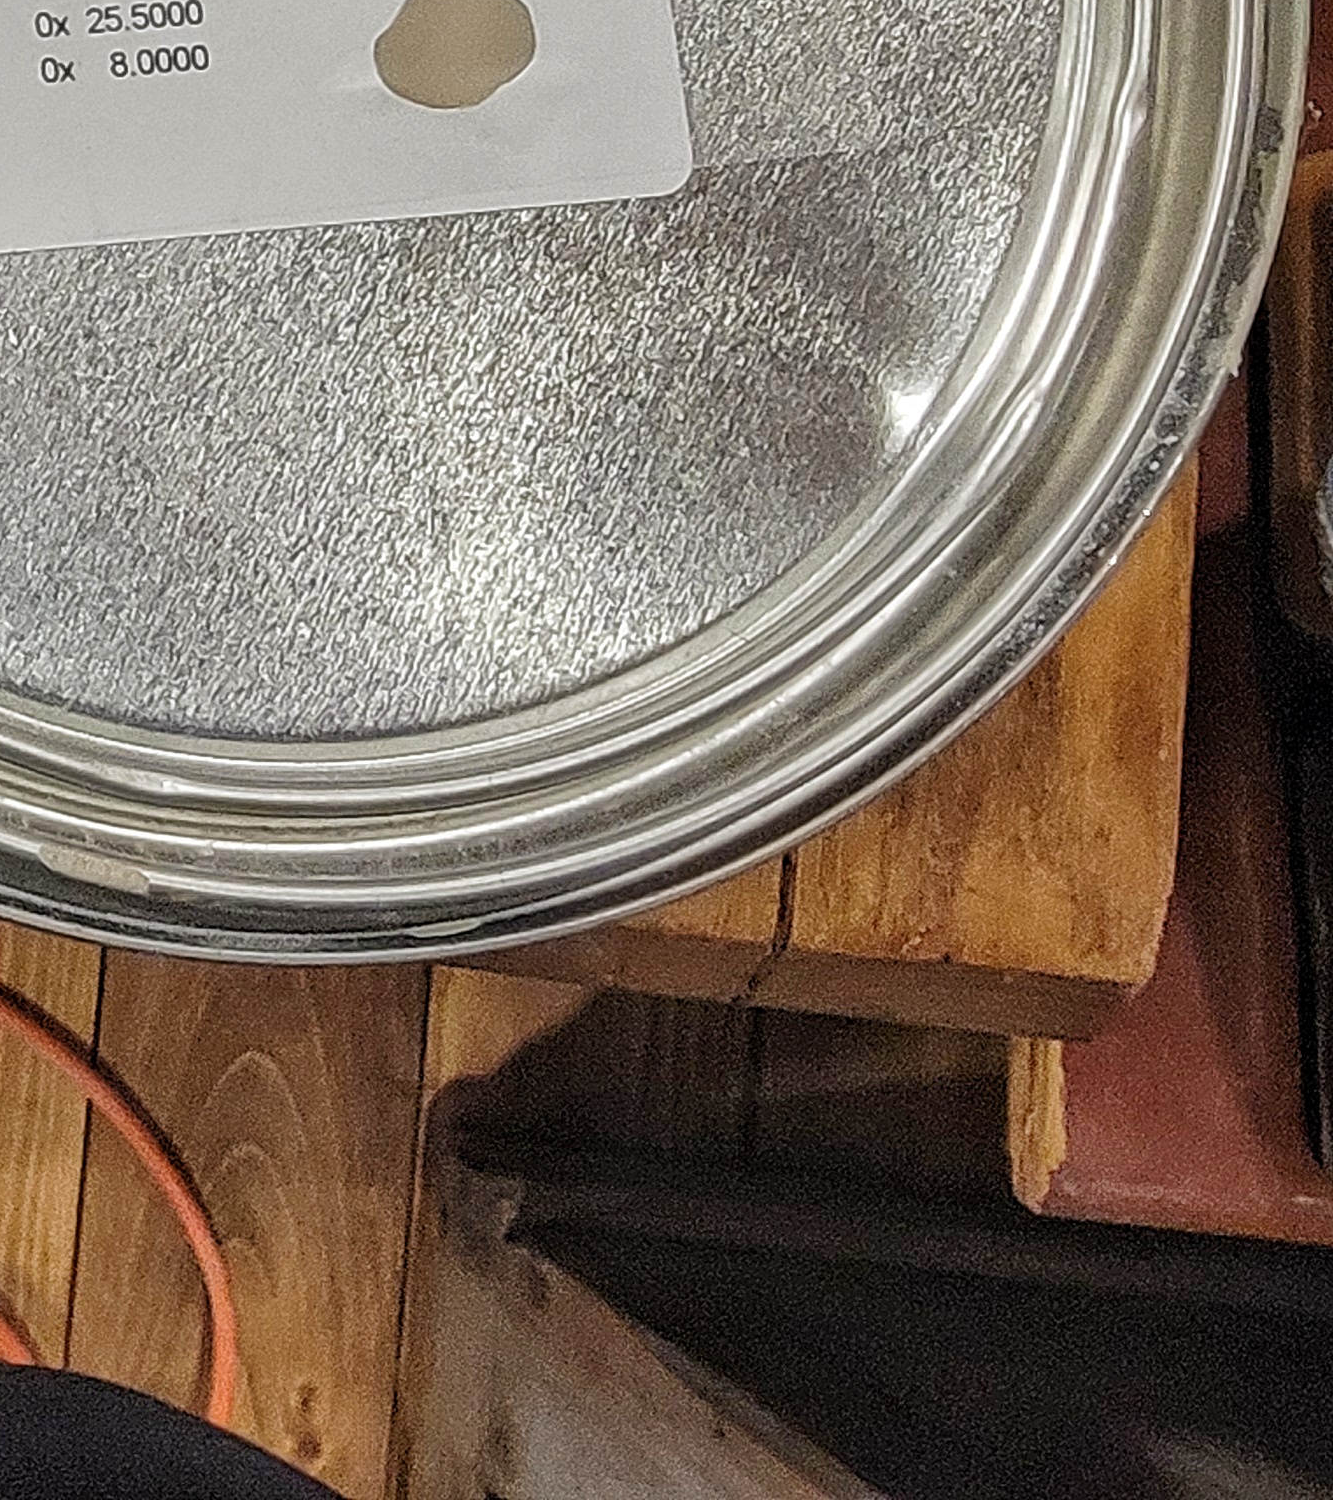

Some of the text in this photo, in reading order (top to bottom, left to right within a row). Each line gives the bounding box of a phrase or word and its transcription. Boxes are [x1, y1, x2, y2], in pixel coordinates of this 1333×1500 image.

[34, 11, 71, 38] 0x
[85, 0, 204, 34] 25.5000
[40, 57, 76, 84] 0x
[109, 44, 210, 78] 8.0000
